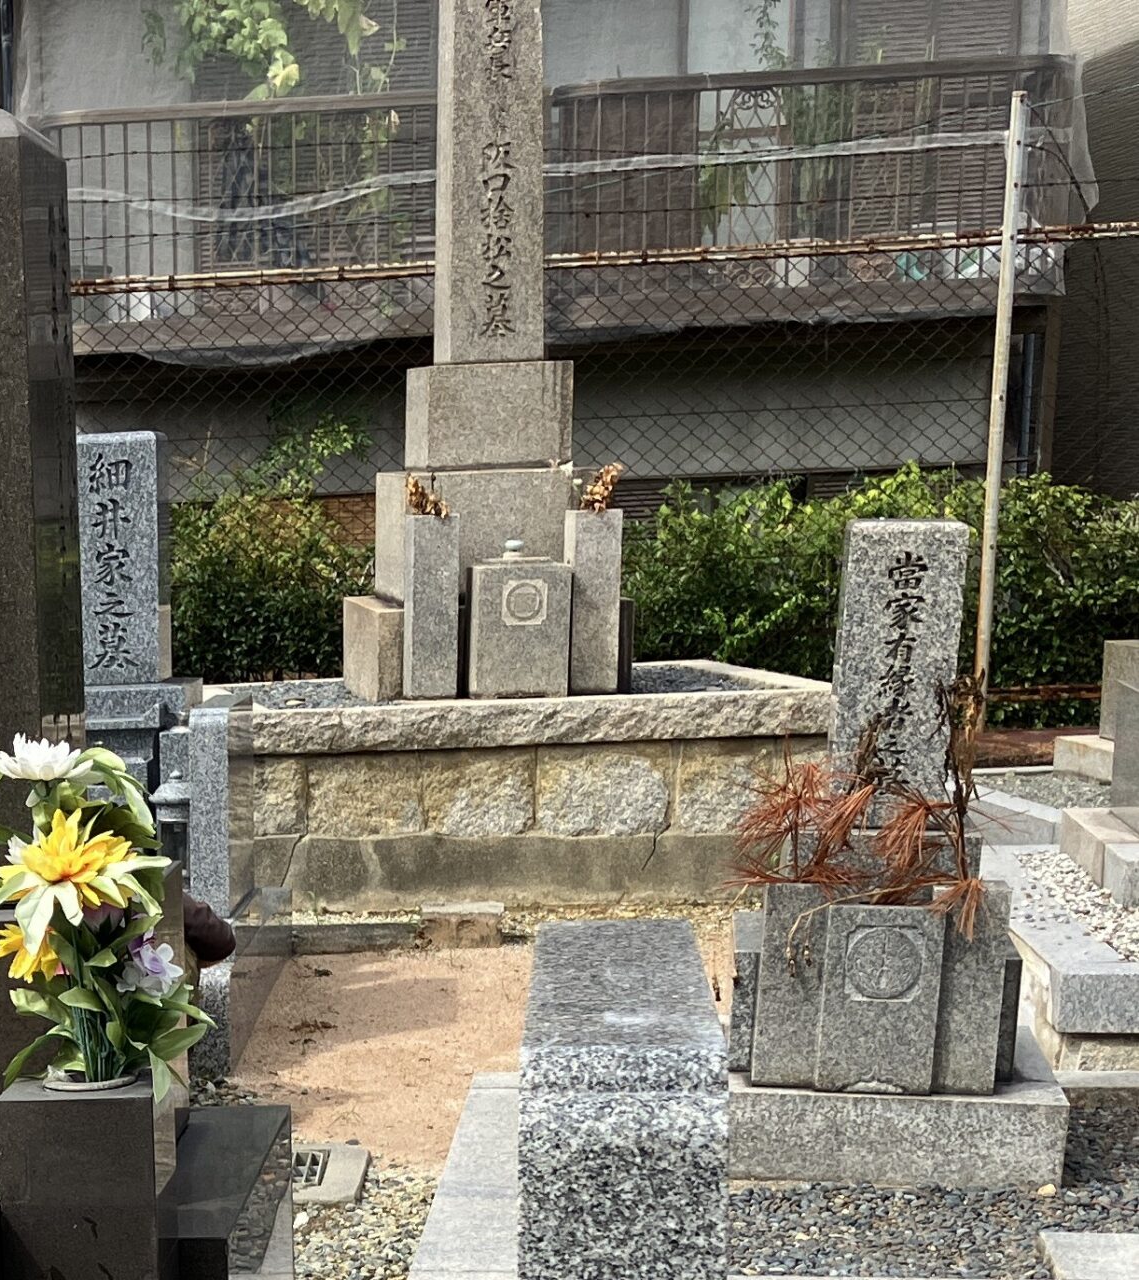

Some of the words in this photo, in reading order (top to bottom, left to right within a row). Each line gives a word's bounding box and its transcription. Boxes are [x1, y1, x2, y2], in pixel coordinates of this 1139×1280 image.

[87, 452, 139, 671] 細井家之墓
